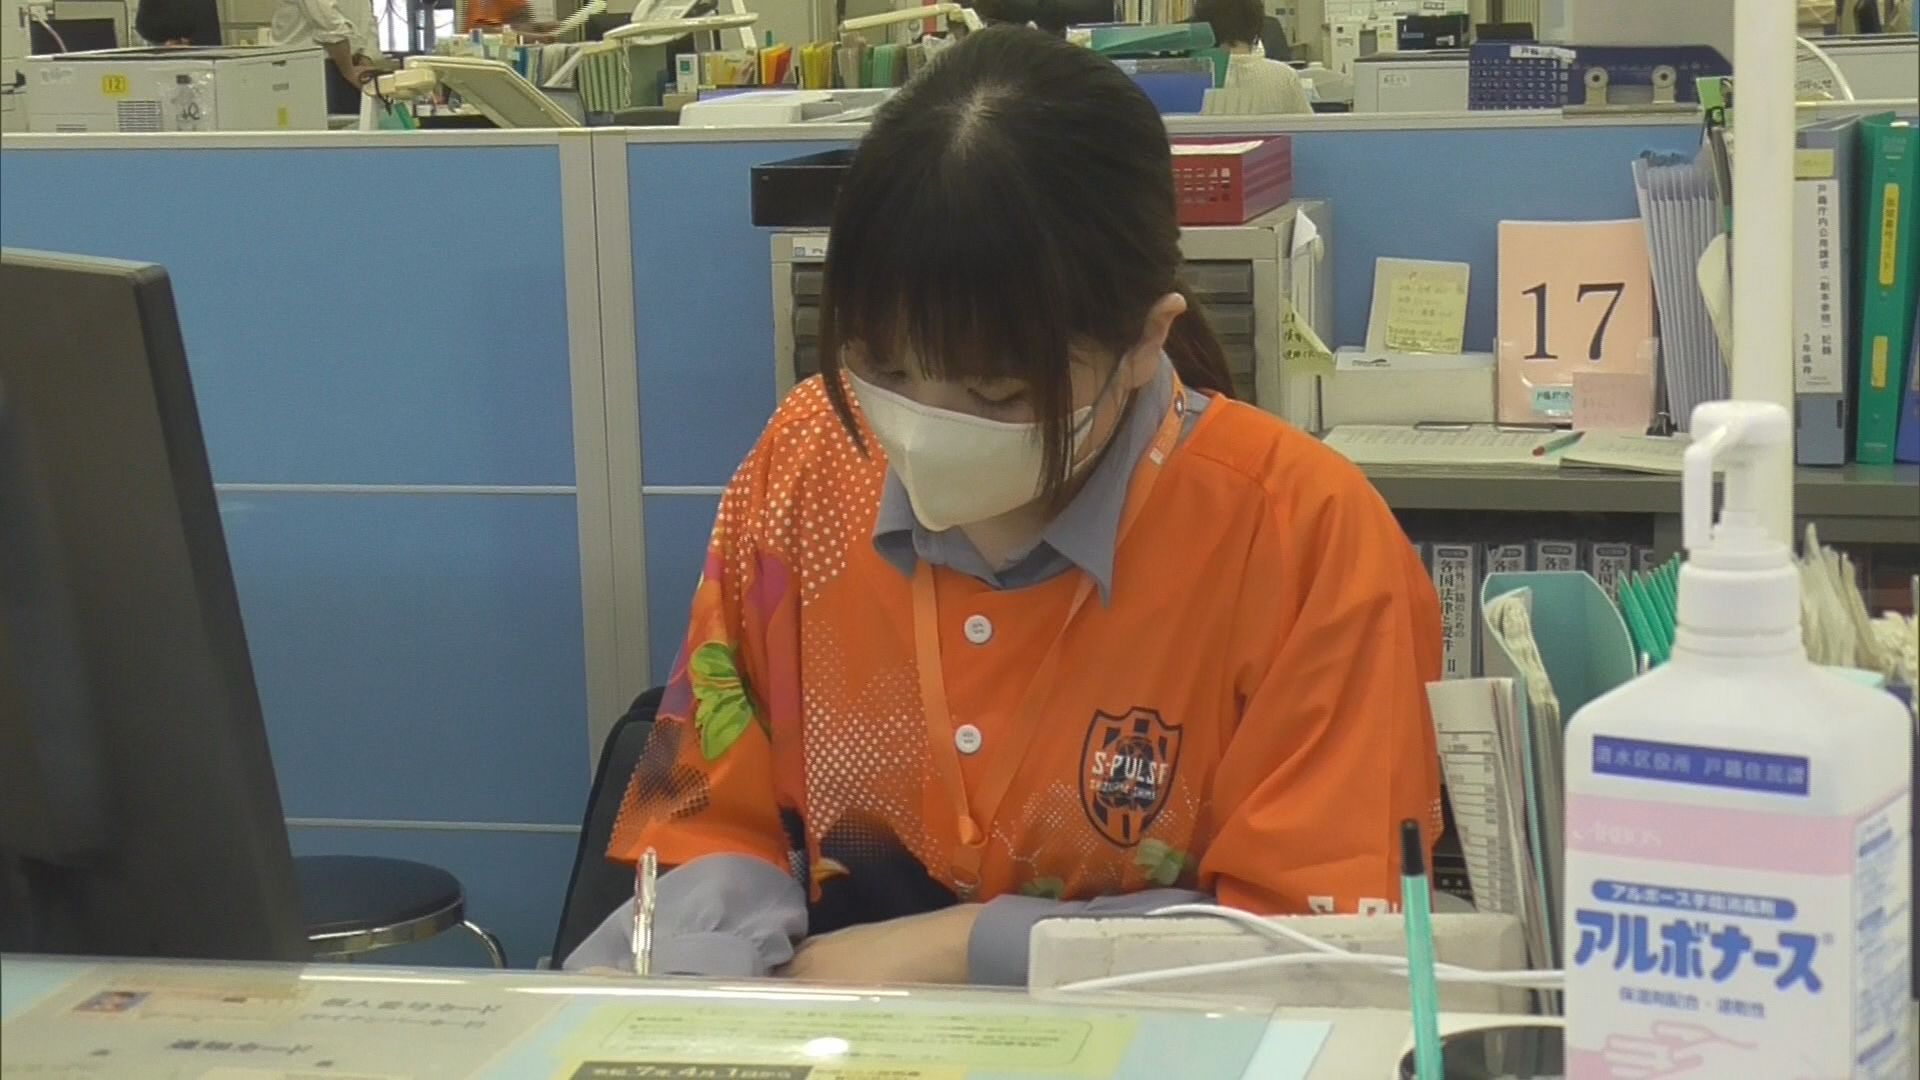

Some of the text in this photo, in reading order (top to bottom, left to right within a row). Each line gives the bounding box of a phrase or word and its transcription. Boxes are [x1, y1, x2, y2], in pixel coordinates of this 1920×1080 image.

[108, 79, 122, 91] 12
[1521, 282, 1625, 360] 17
[1703, 756, 1804, 785] 戸籍住民課
[1573, 908, 1823, 994] アルボナース
